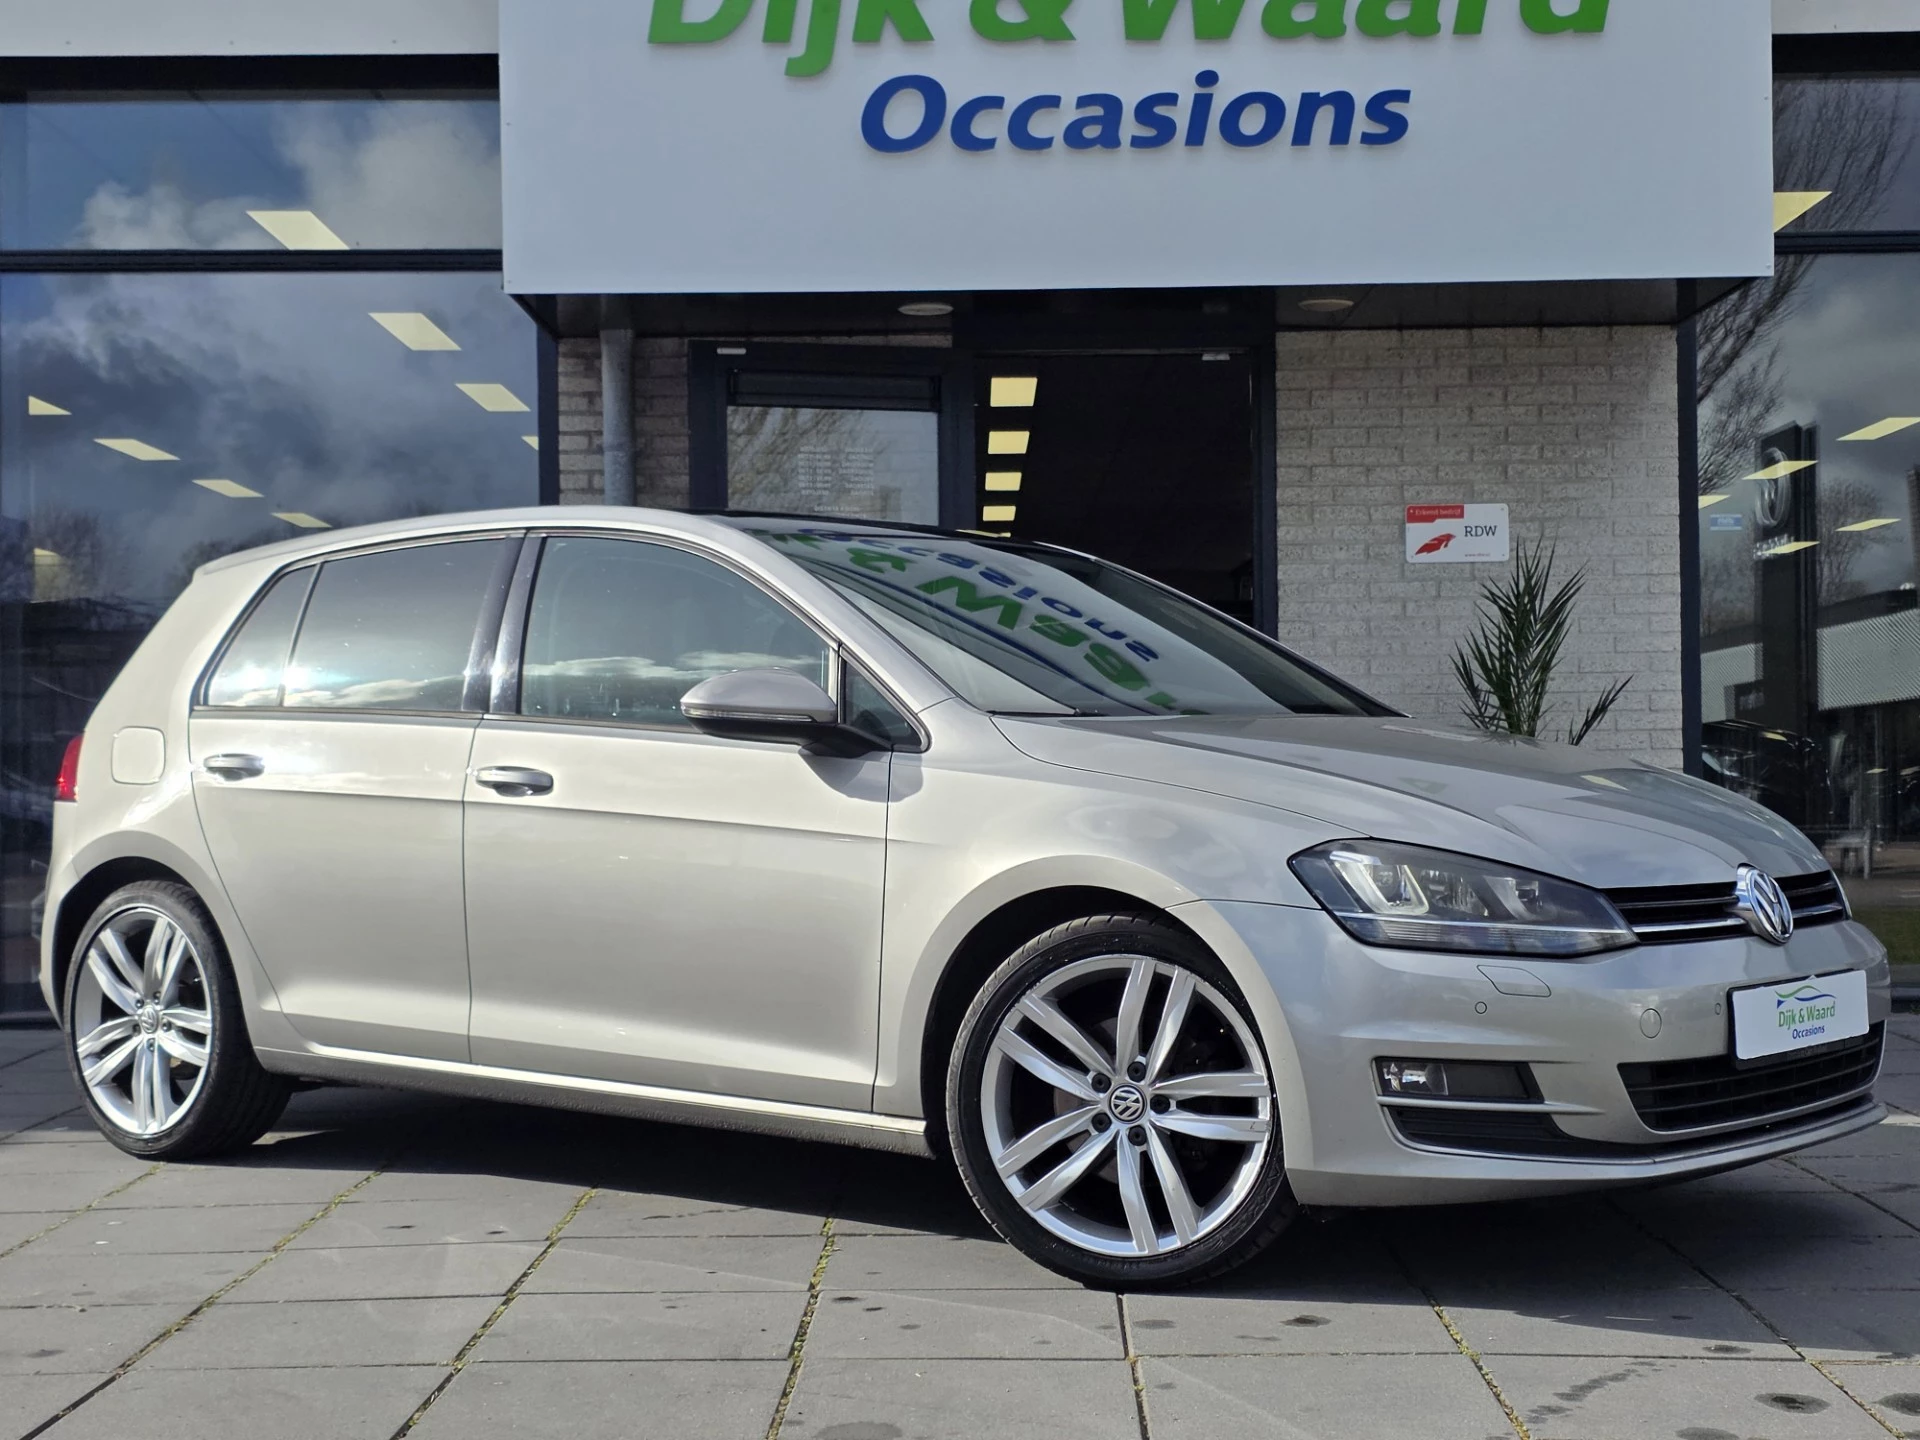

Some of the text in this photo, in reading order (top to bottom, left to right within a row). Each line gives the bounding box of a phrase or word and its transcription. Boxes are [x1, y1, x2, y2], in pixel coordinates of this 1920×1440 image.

[860, 69, 1412, 154] Occasions
[1464, 525, 1498, 537] RDW
[1778, 1000, 1836, 1031] Dijk & Waard
[1792, 1024, 1826, 1040] Occasions
